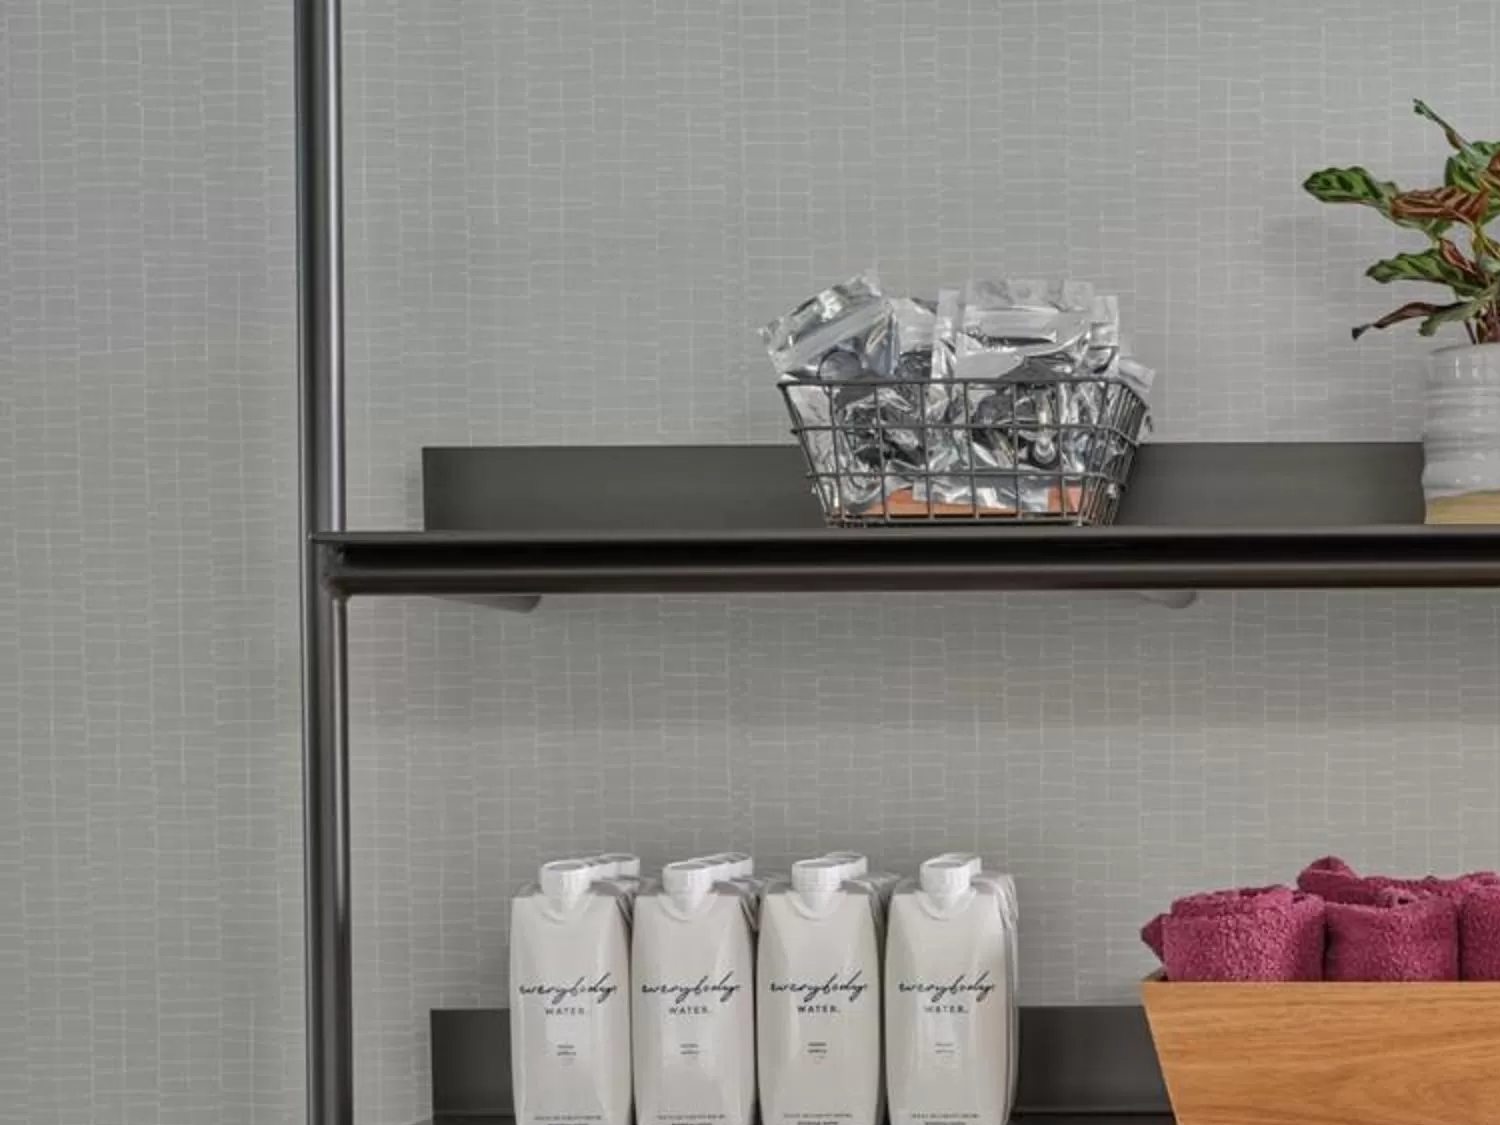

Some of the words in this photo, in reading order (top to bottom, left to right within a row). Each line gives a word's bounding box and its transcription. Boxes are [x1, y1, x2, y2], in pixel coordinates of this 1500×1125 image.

[519, 972, 618, 1005] everybody
[641, 971, 741, 1004] everybody
[769, 970, 868, 1003] everybody
[899, 971, 995, 1003] everybody
